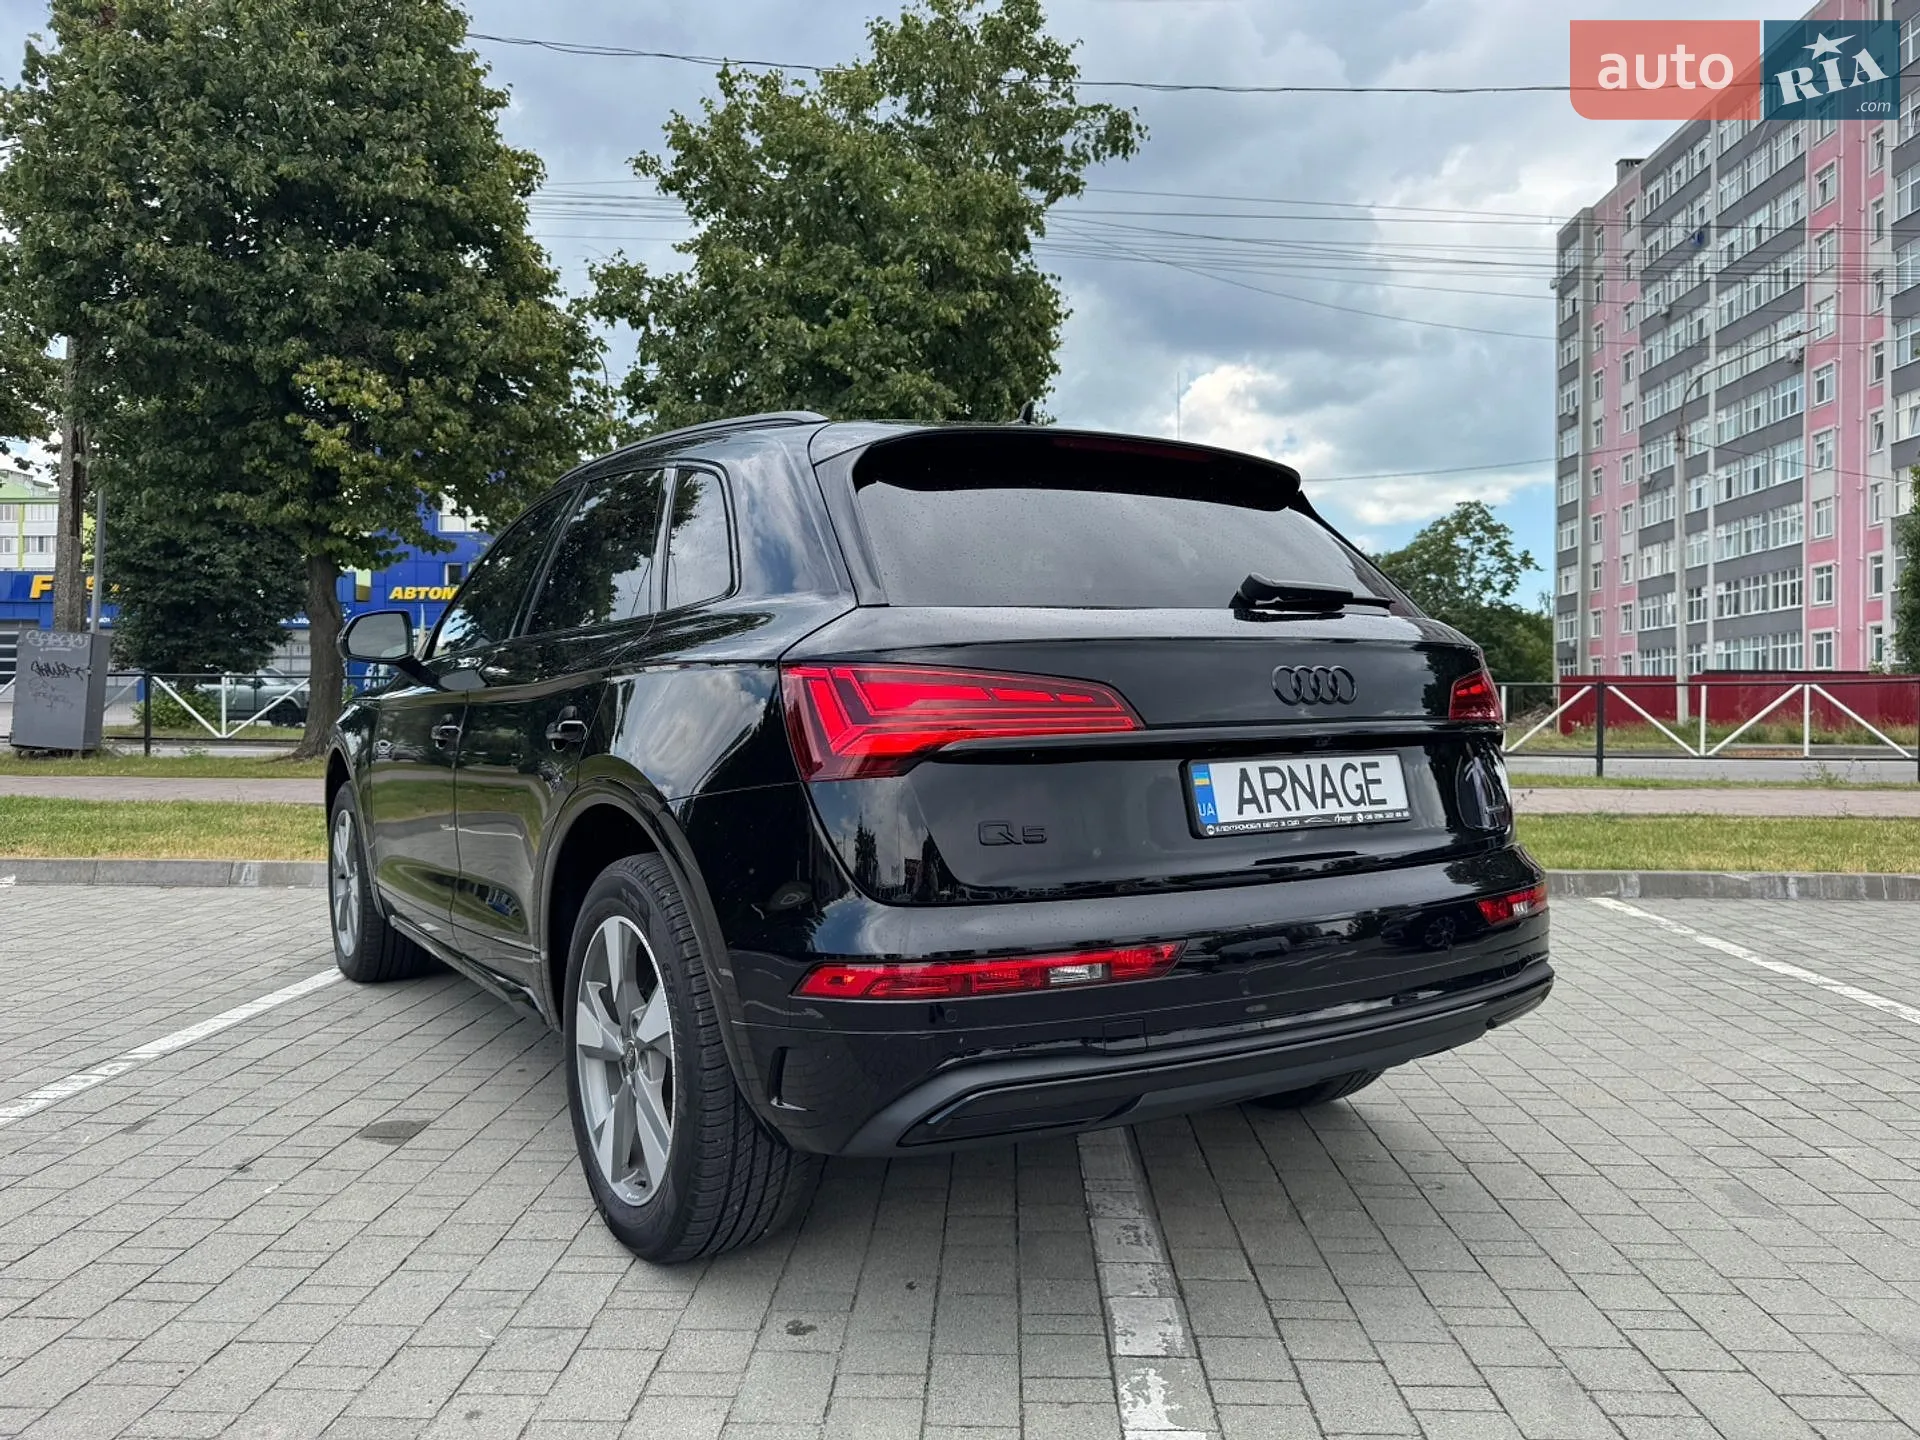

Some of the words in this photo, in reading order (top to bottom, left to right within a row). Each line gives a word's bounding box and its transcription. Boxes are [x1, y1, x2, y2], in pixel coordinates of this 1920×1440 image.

[1237, 761, 1388, 815] ARNAGE
[1199, 803, 1216, 817] UA
[978, 820, 1047, 846] Q5
